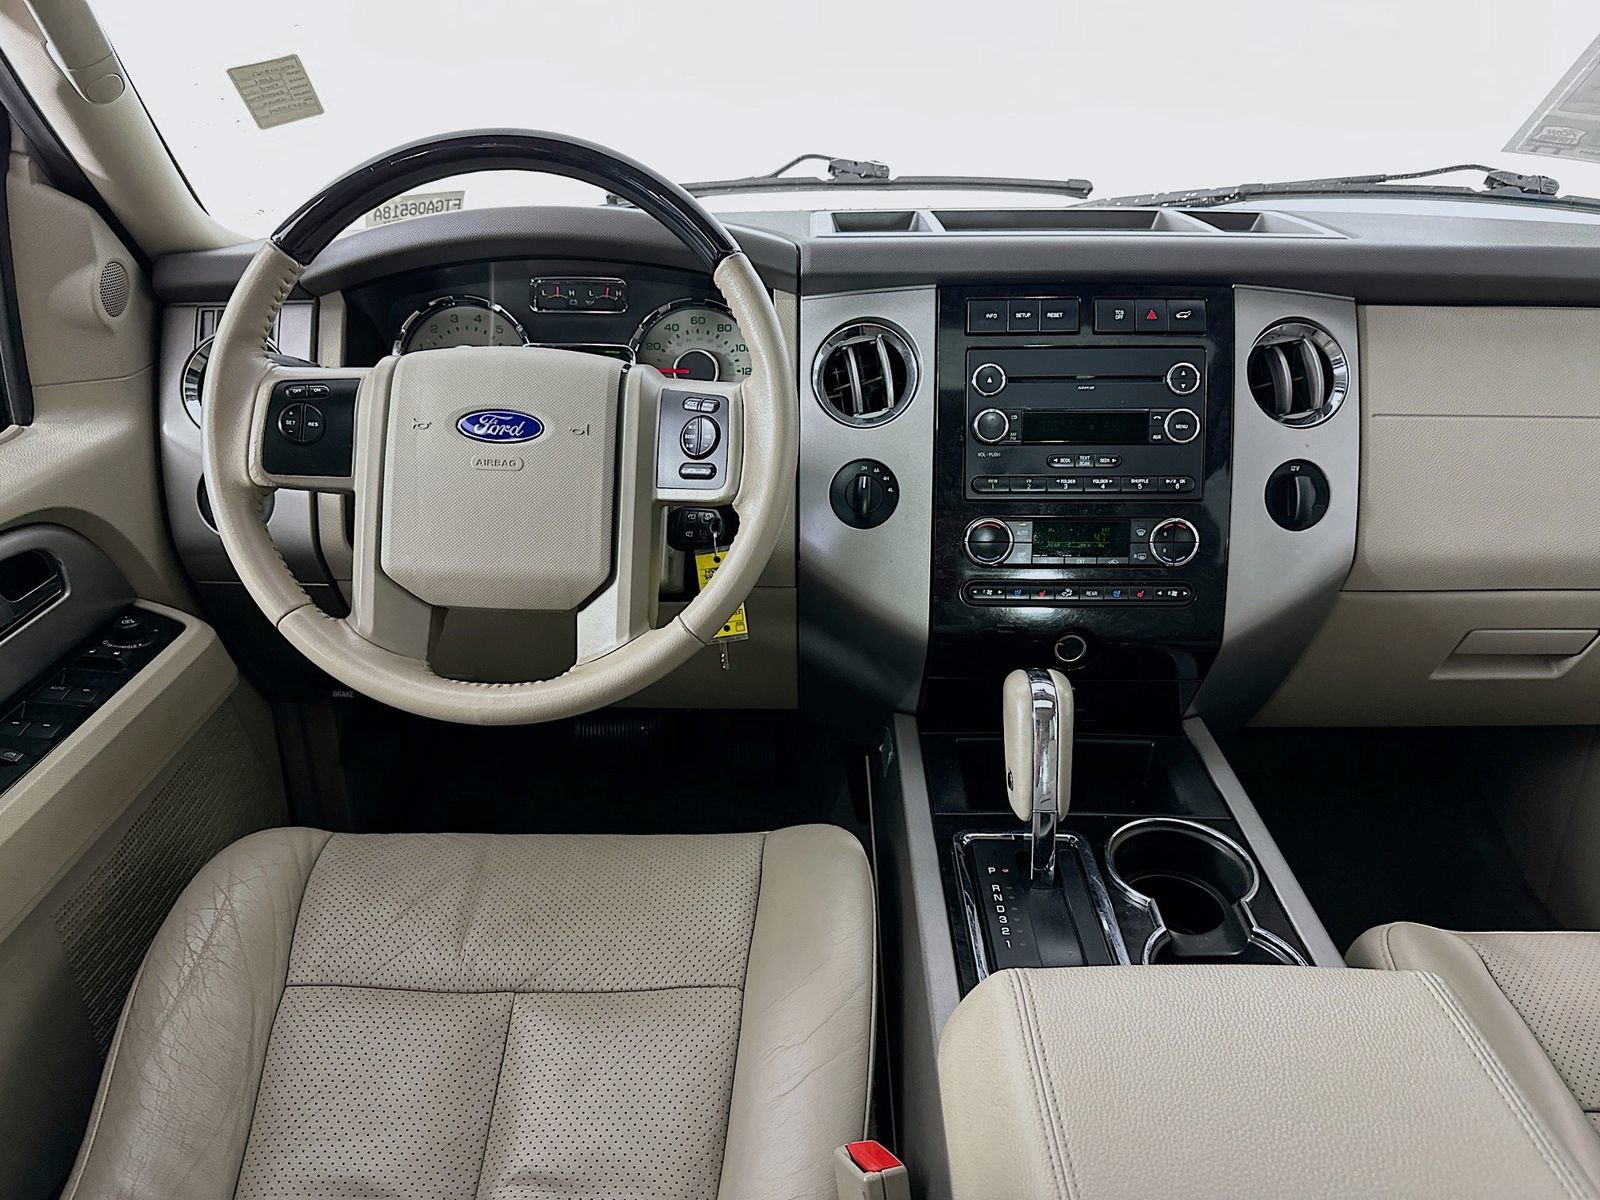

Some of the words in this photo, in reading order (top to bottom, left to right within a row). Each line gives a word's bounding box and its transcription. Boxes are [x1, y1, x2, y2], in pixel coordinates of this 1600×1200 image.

[450, 314, 458, 323] 3
[474, 314, 482, 323] 4
[691, 316, 706, 324] 60
[430, 324, 438, 333] 2
[496, 325, 504, 334] 5
[664, 324, 679, 332] 40
[717, 324, 732, 332] 80
[646, 342, 660, 350] 20
[473, 414, 526, 436] Ford
[476, 458, 517, 467] AIRBAG
[1006, 940, 1012, 948] 1
